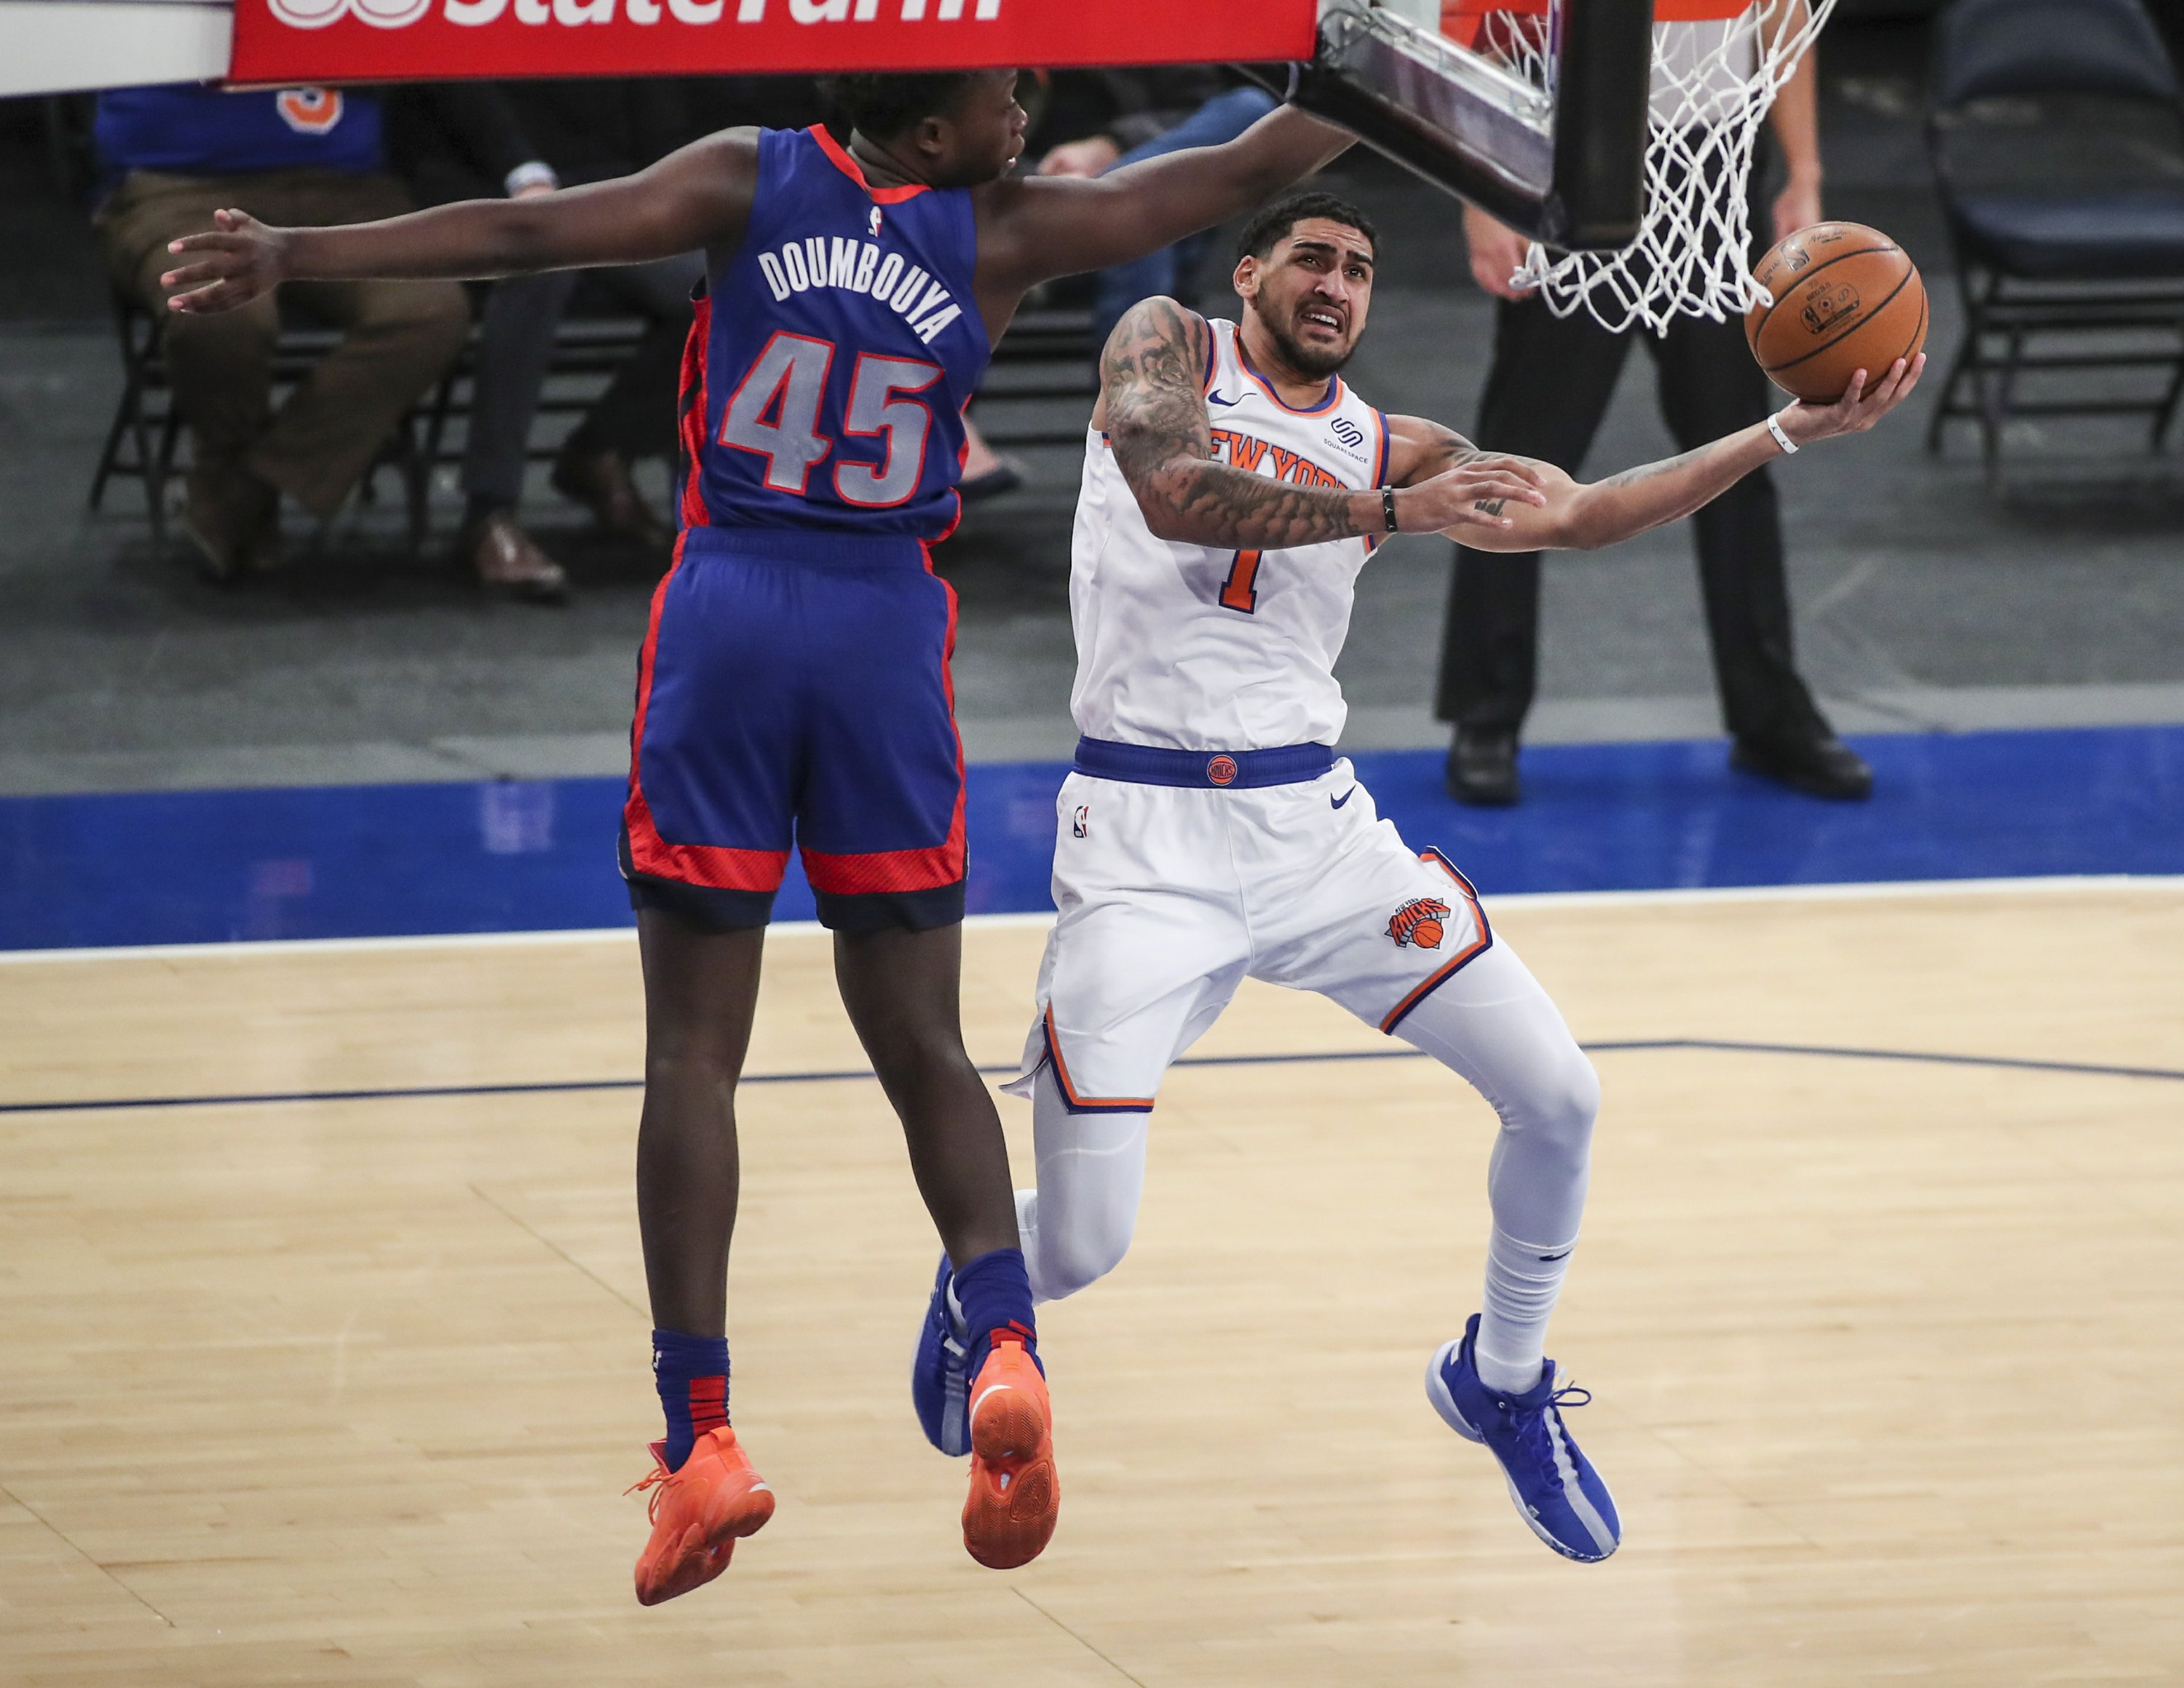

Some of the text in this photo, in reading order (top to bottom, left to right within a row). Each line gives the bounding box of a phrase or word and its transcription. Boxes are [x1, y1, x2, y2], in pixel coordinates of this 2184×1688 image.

[758, 236, 962, 344] DOUMBOUYA
[718, 330, 944, 508] 45
[1210, 428, 1348, 490] EW YO
[1324, 438, 1368, 464] SQUARESPACE
[1219, 550, 1263, 615] 1
[1389, 898, 1451, 947] KNICKS
